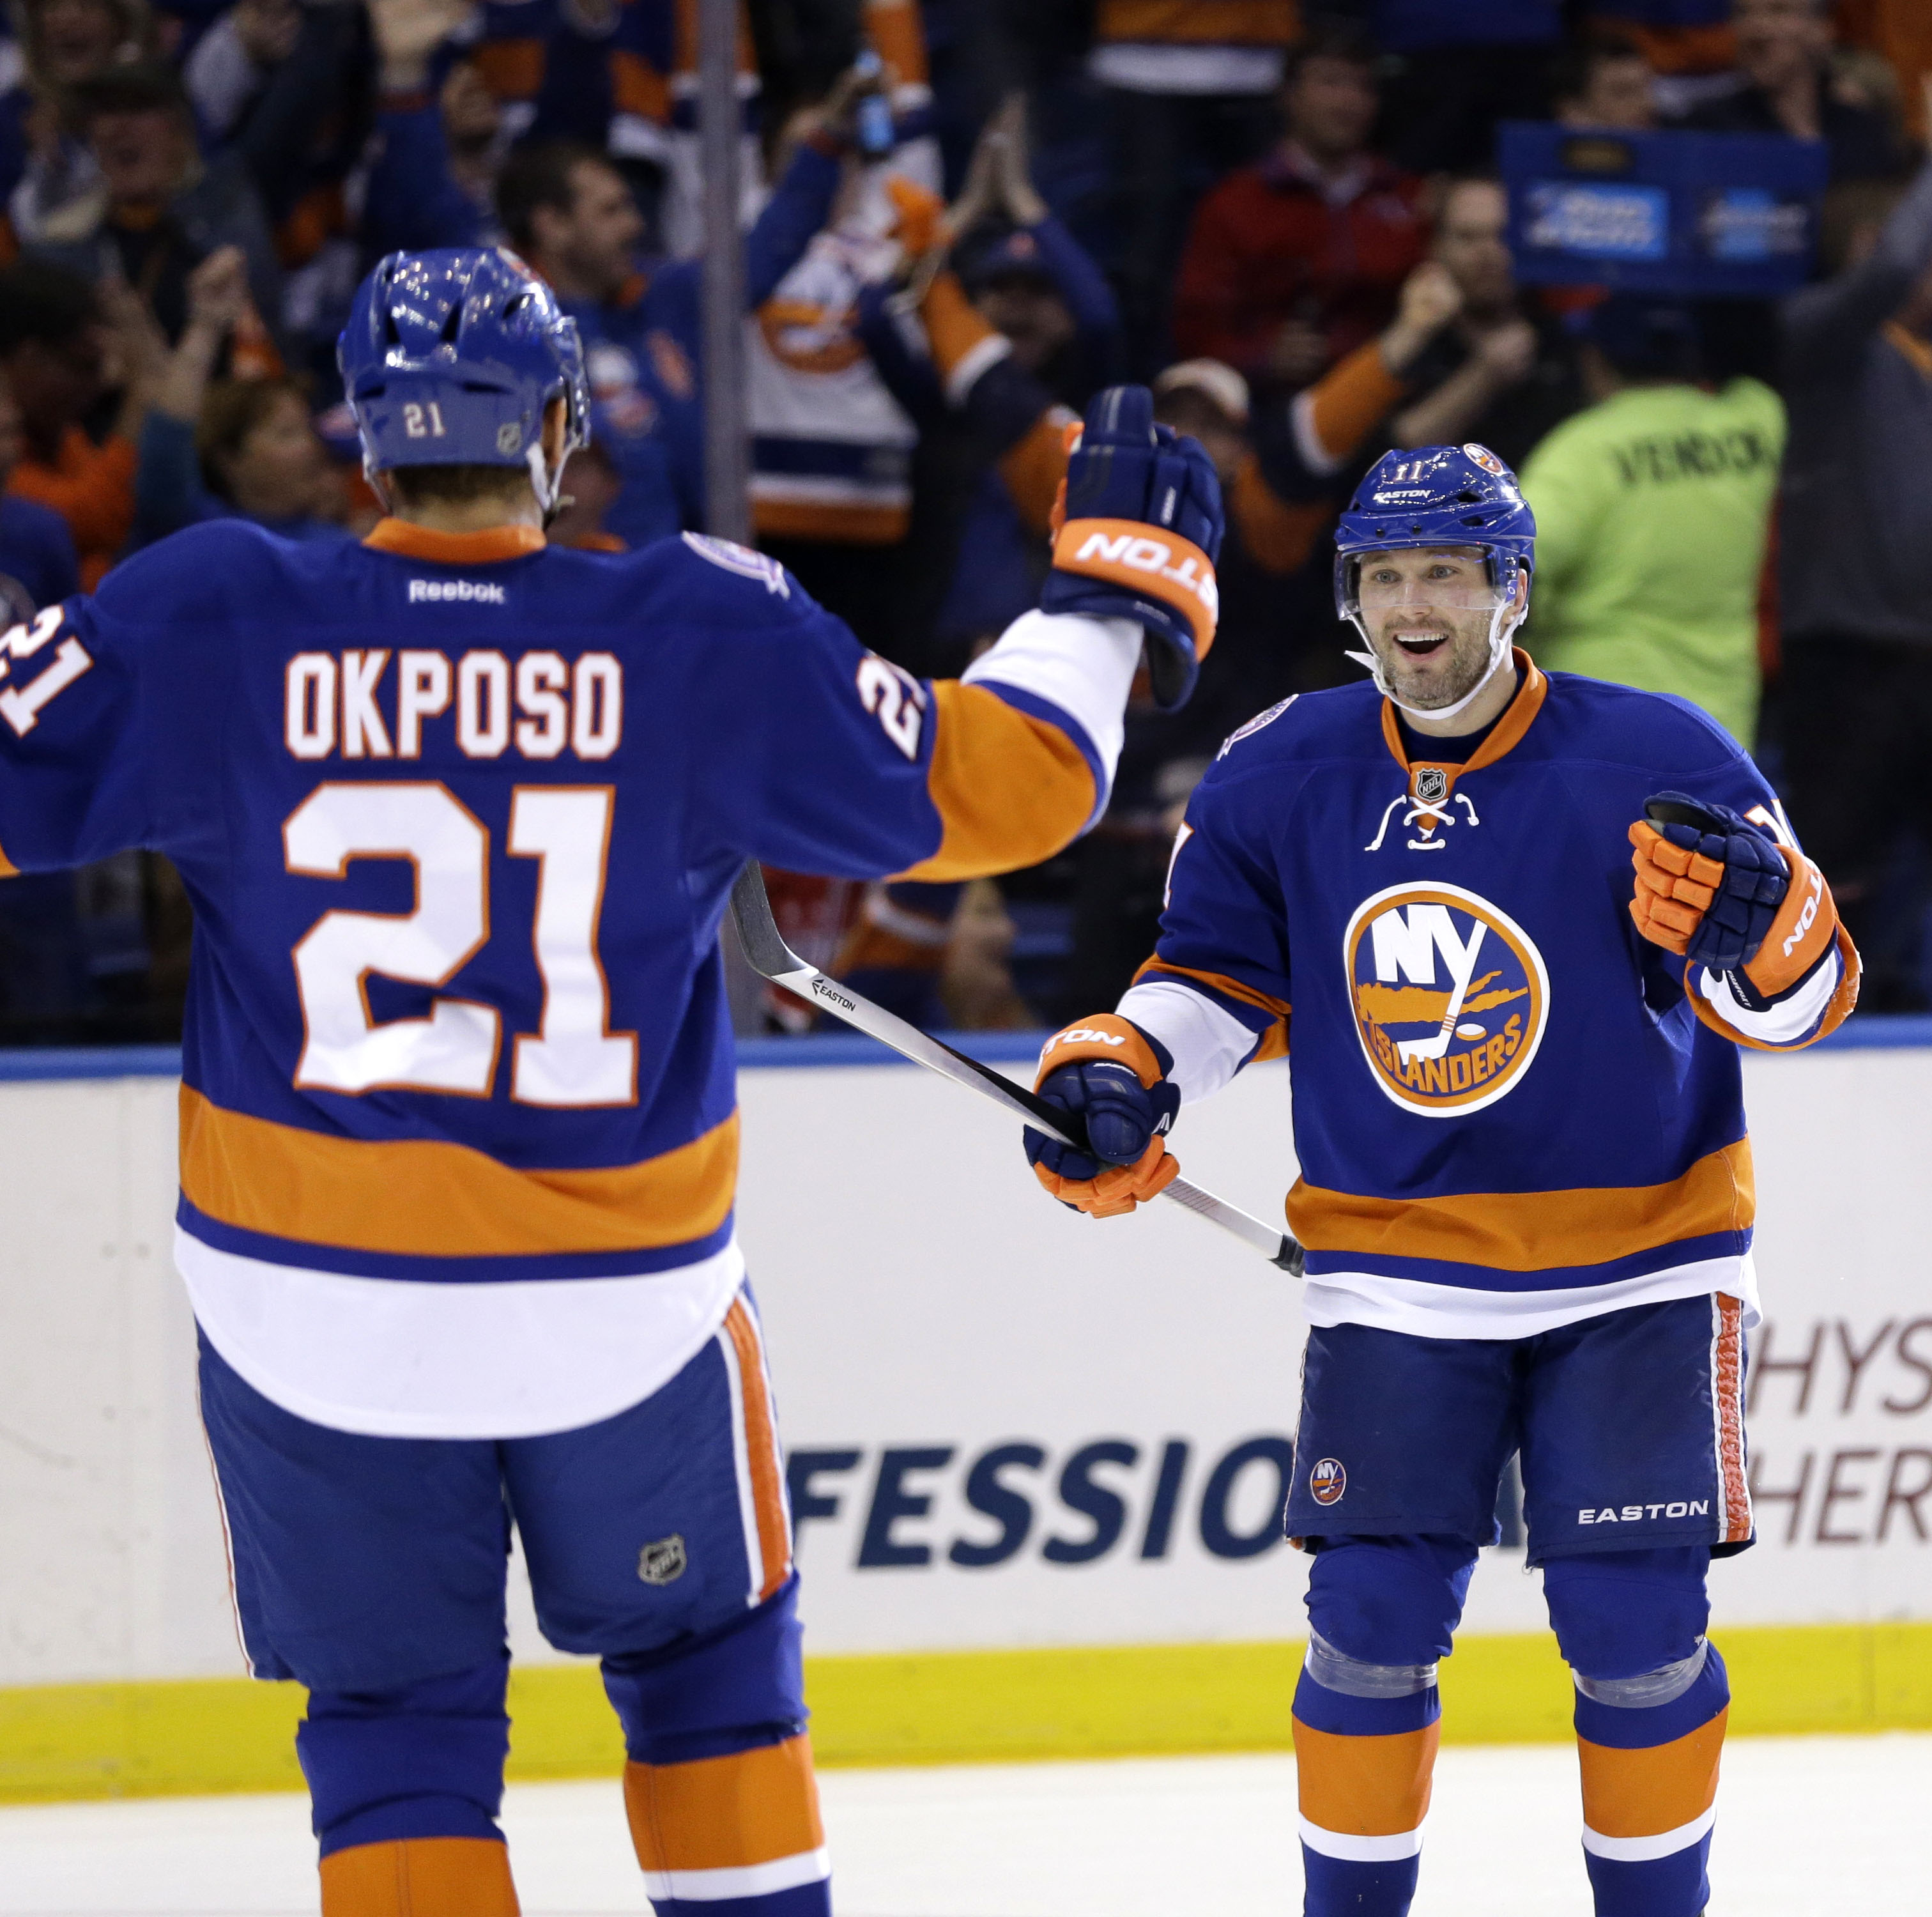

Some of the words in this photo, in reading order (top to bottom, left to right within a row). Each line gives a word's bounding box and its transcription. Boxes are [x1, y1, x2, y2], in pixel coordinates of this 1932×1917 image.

[403, 401, 445, 438] 21
[1393, 461, 1424, 482] 11
[1372, 489, 1432, 500] EASTON
[408, 579, 505, 605] Reebok
[284, 648, 624, 761] OKPOSO
[281, 779, 639, 1109] 21
[1371, 904, 1488, 998] NY
[819, 985, 857, 1012] EASTON
[1039, 1029, 1126, 1062] TON
[1366, 1012, 1522, 1093] ISLANDERS
[1747, 1318, 1932, 1417] HYS
[785, 1435, 1294, 1570] FESSIO
[1578, 1499, 1710, 1525] EASTON
